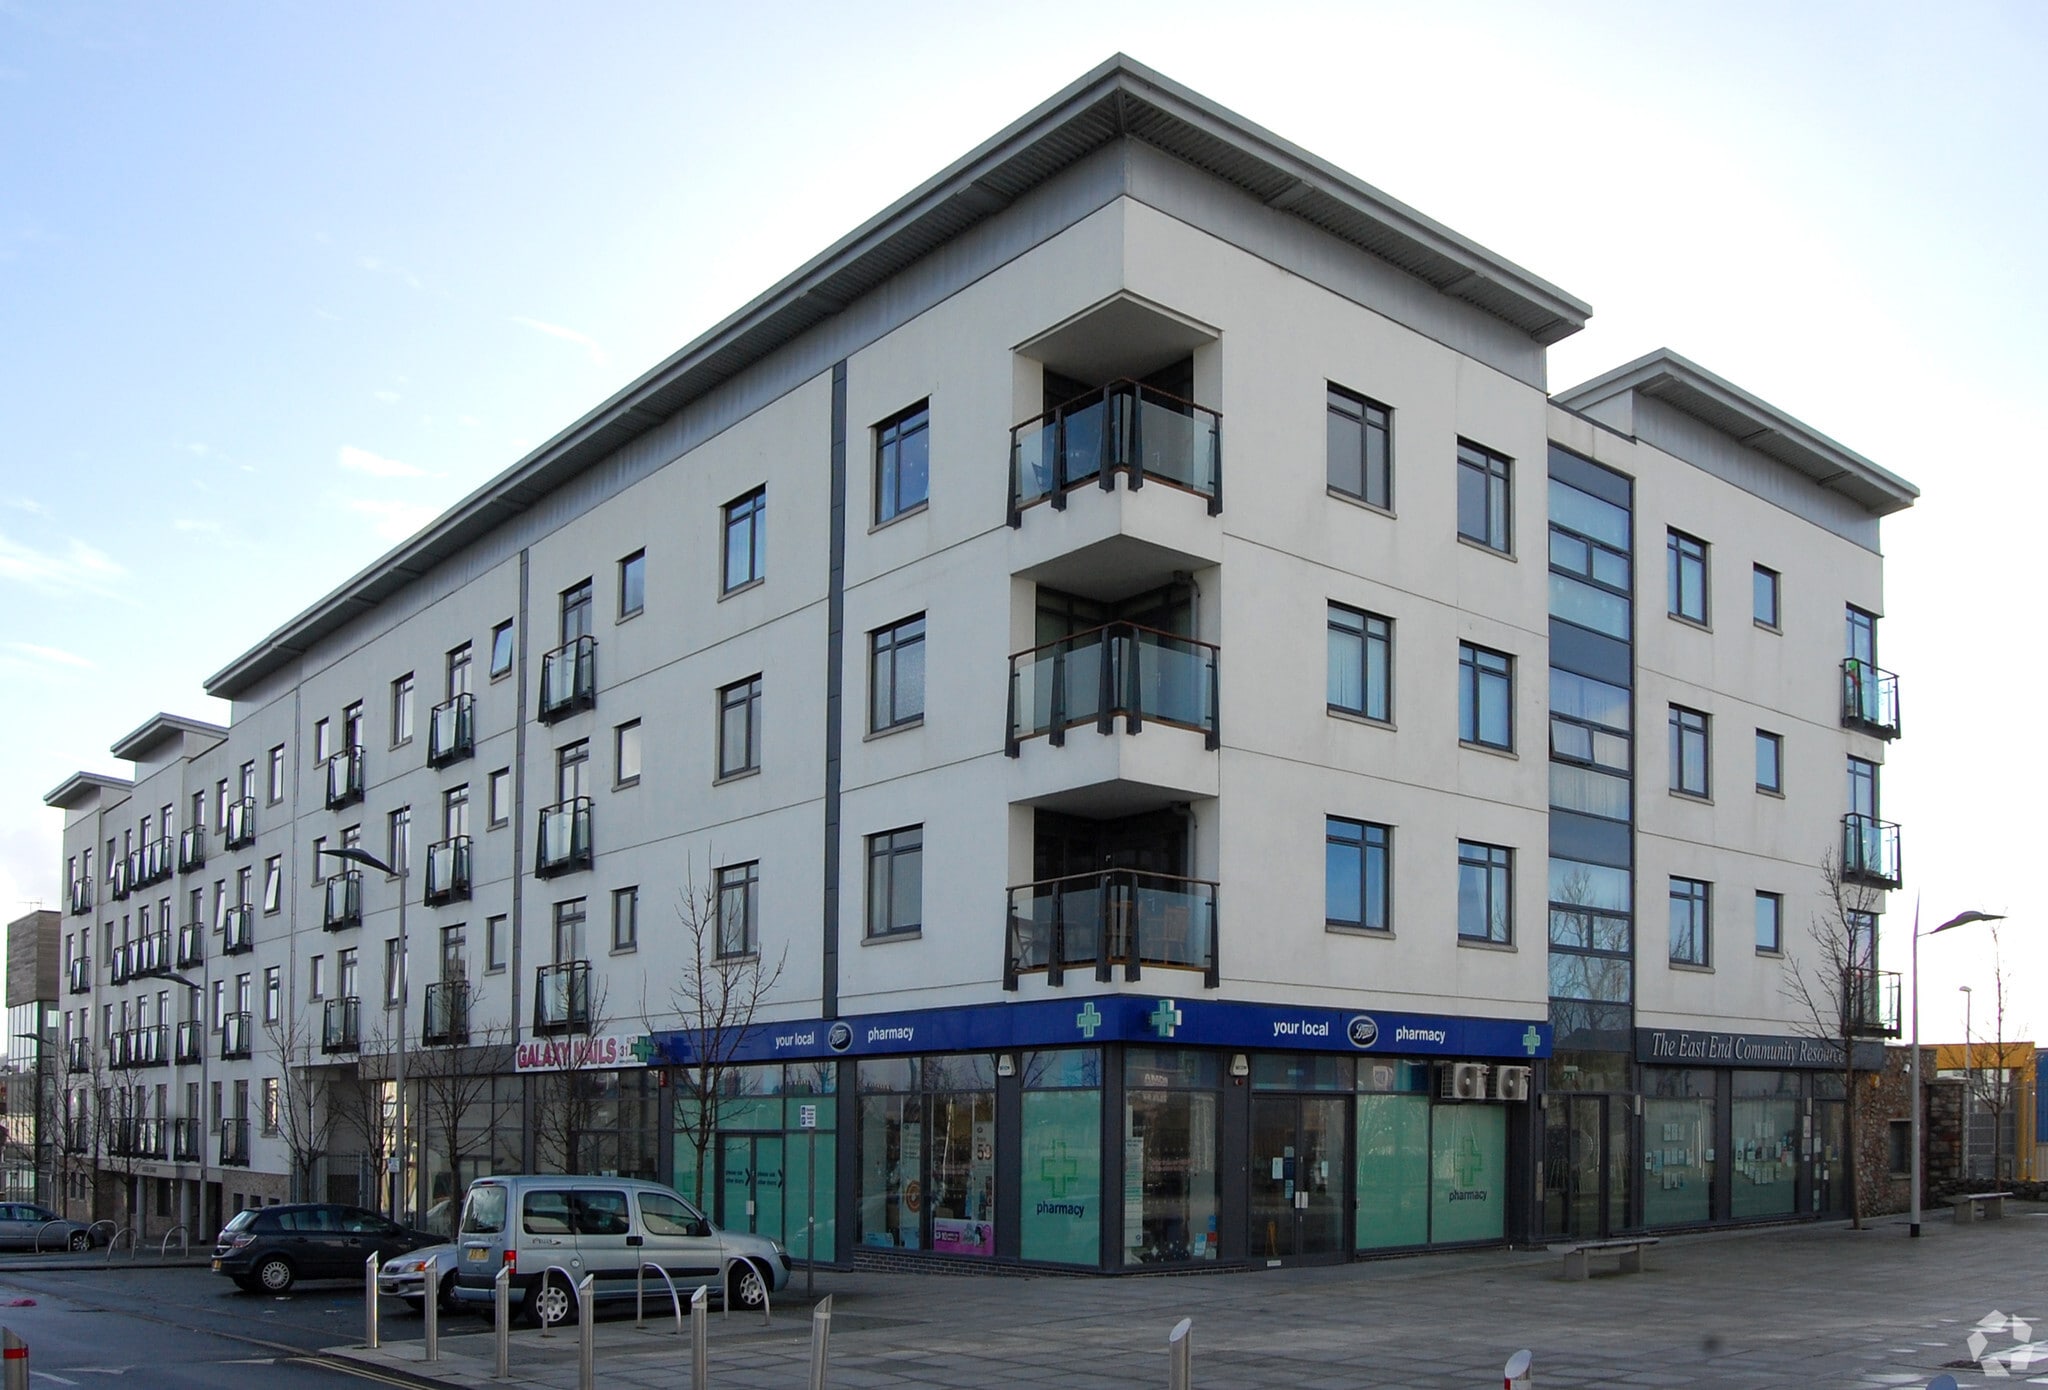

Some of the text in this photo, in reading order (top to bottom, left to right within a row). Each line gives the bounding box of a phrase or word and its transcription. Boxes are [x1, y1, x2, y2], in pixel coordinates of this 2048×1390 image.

[867, 1027, 914, 1043] pharmacy
[1273, 1020, 1329, 1037] your local
[1395, 1026, 1446, 1044] pharmacy
[775, 1031, 815, 1049] your local
[1652, 1032, 1675, 1057] The
[1679, 1034, 1706, 1058] East
[1708, 1035, 1733, 1059] End
[1735, 1036, 1798, 1066] Community
[517, 1037, 617, 1068] GALAXY NAILS
[1449, 1190, 1488, 1203] pharmacy
[1036, 1200, 1085, 1219] pharmacy
